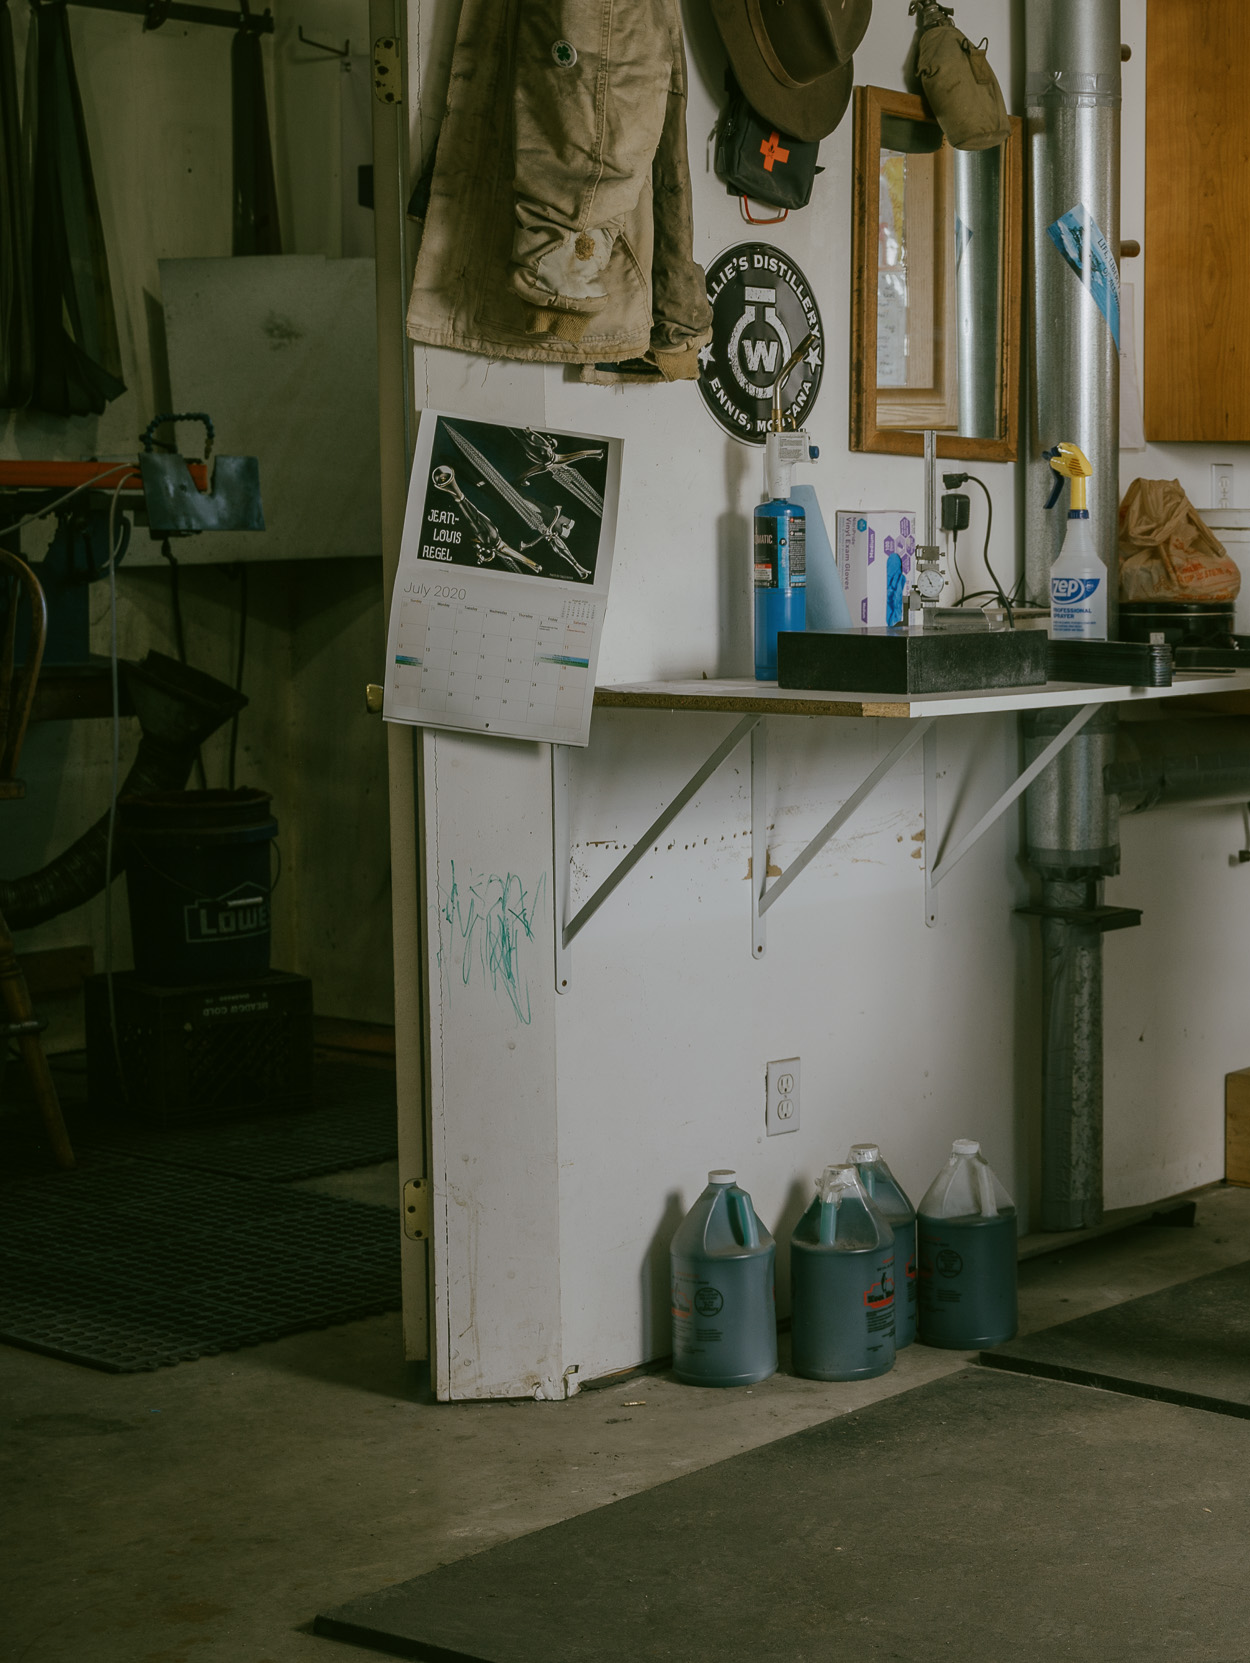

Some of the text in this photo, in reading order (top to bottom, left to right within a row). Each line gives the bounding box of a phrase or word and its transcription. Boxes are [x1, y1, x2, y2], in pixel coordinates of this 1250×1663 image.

[1097, 238, 1110, 260] LIFE,
[706, 254, 821, 338] LLIE'S DISTILLERY
[742, 340, 778, 372] W
[708, 377, 812, 432] ENNIS, MOTANA
[428, 508, 460, 526] JEAN-
[433, 528, 462, 544] LOUIS
[422, 545, 452, 562] REGEL
[404, 582, 467, 600] July 2020
